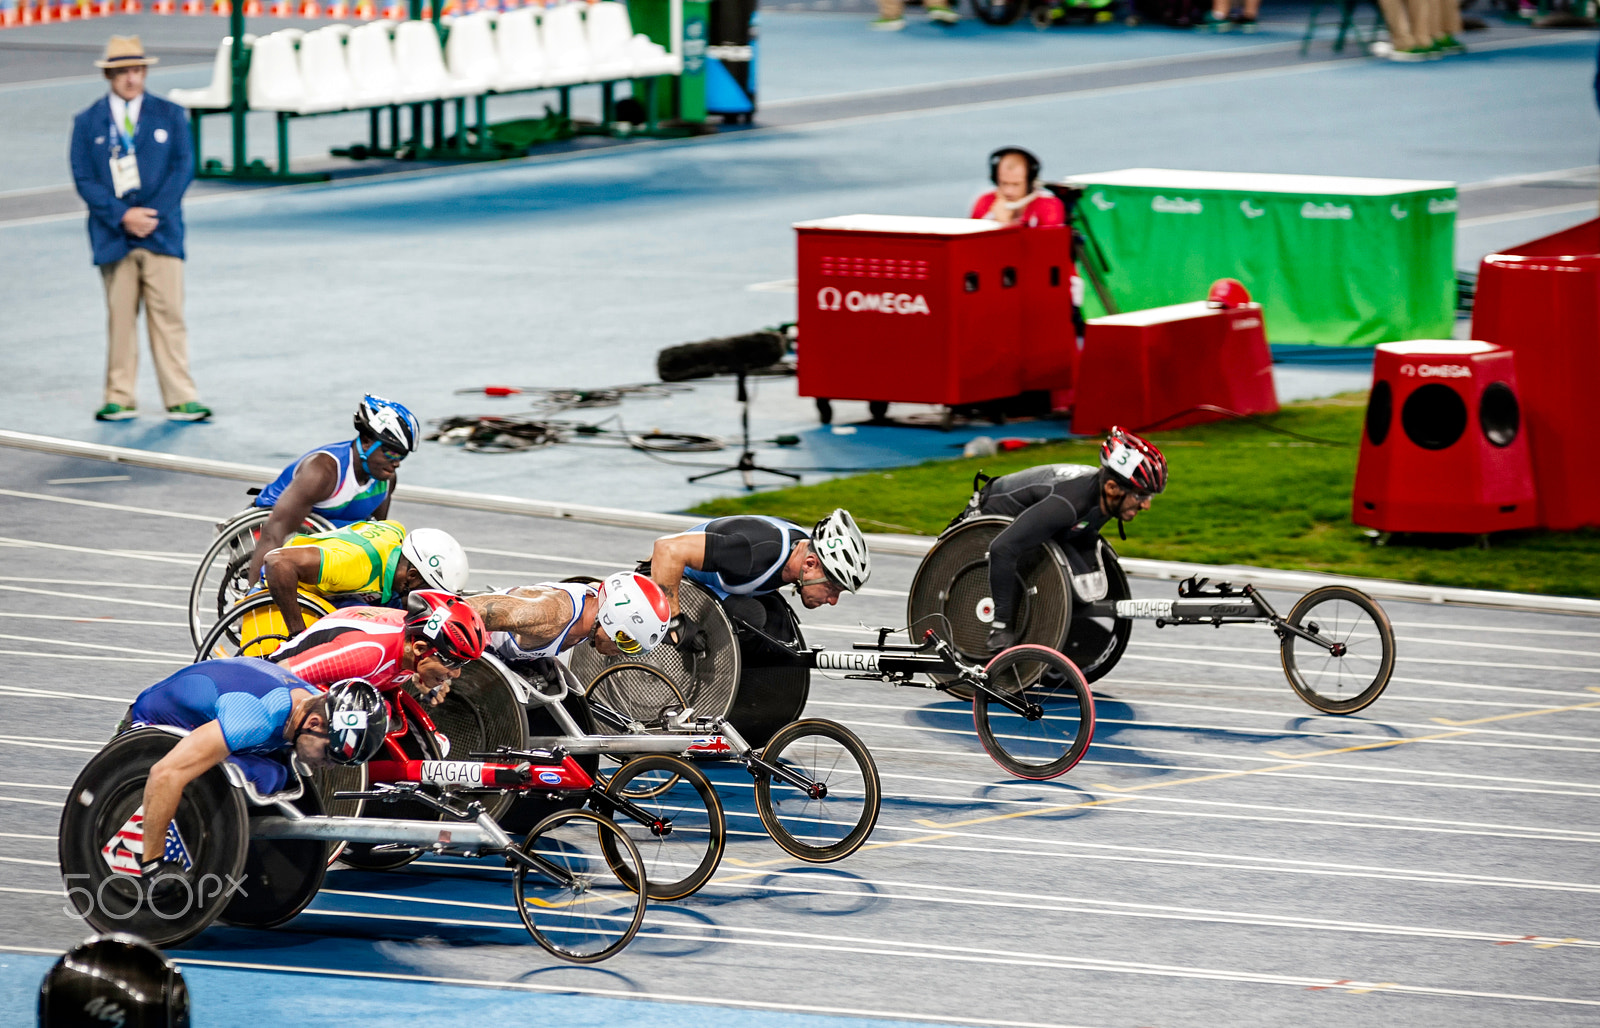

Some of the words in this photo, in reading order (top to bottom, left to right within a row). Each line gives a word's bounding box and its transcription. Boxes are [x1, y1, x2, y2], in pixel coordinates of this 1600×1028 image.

[845, 290, 931, 315] OMEGA
[1117, 450, 1131, 466] 3
[826, 538, 843, 549] 5
[429, 554, 446, 567] 6
[614, 593, 631, 607] 7
[427, 613, 443, 631] 8
[420, 761, 482, 783] NAGAO
